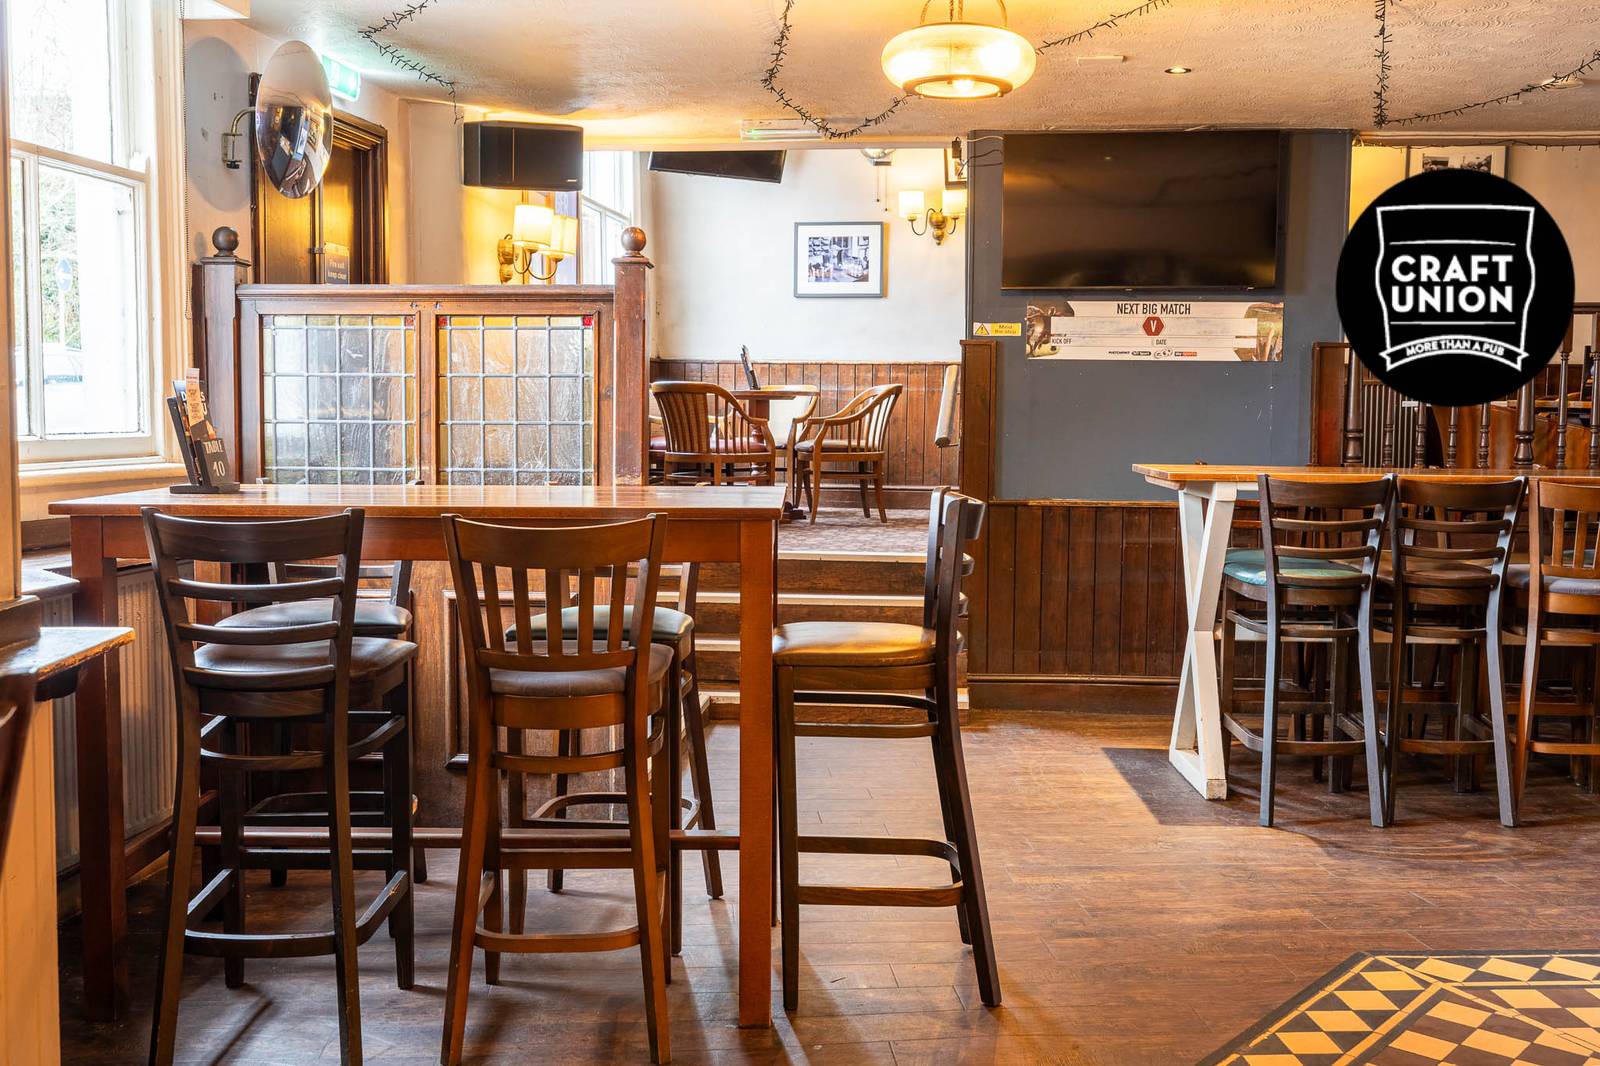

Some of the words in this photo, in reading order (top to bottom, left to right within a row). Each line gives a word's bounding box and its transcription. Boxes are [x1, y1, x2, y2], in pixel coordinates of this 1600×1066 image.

[1117, 303, 1140, 315] NEXT
[1142, 303, 1158, 315] BIG
[1160, 303, 1191, 315] MATCH
[1150, 319, 1157, 333] V
[203, 439, 224, 454] TABLE
[212, 461, 226, 477] 10
